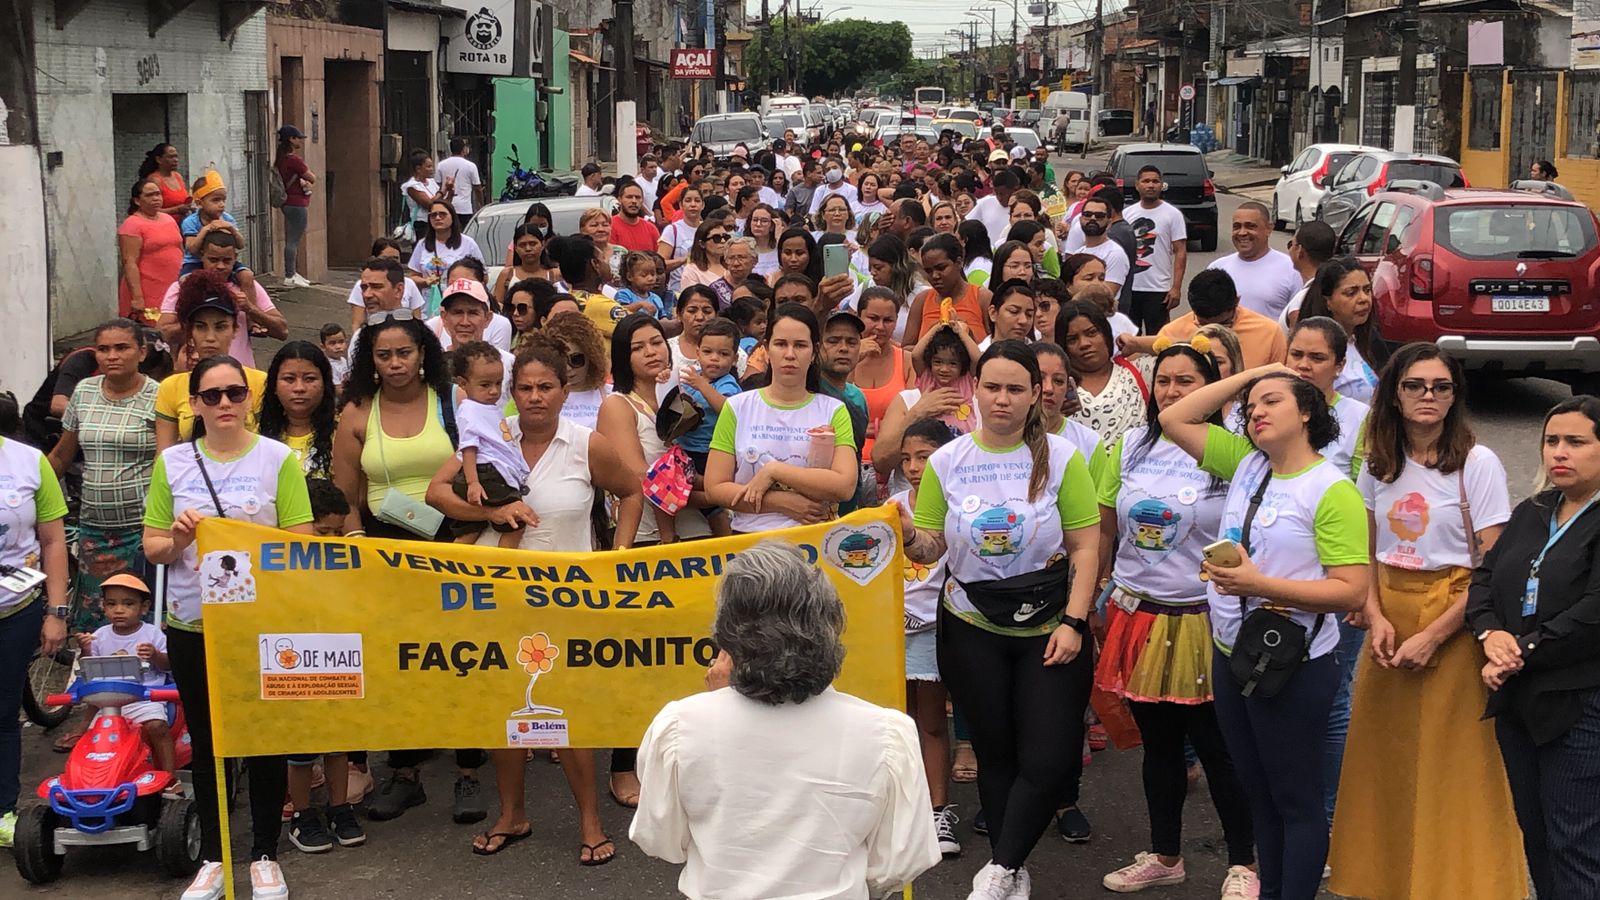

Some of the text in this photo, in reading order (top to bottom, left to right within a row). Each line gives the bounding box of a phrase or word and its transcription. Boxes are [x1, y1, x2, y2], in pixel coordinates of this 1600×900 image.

[460, 52, 507, 64] ROTA 18
[676, 50, 712, 69] AÇAÍ
[684, 67, 712, 76] VITÓRIA
[959, 473, 998, 485] MARINHO
[1000, 473, 1011, 481] DE
[260, 541, 361, 571] EMEI
[376, 548, 594, 584] VENUZINA
[441, 582, 675, 611] DE SOUZA
[303, 650, 319, 668] DE
[324, 650, 361, 668] MAIO
[399, 637, 718, 676] FAÇA BONITO
[532, 721, 566, 730] Belém
